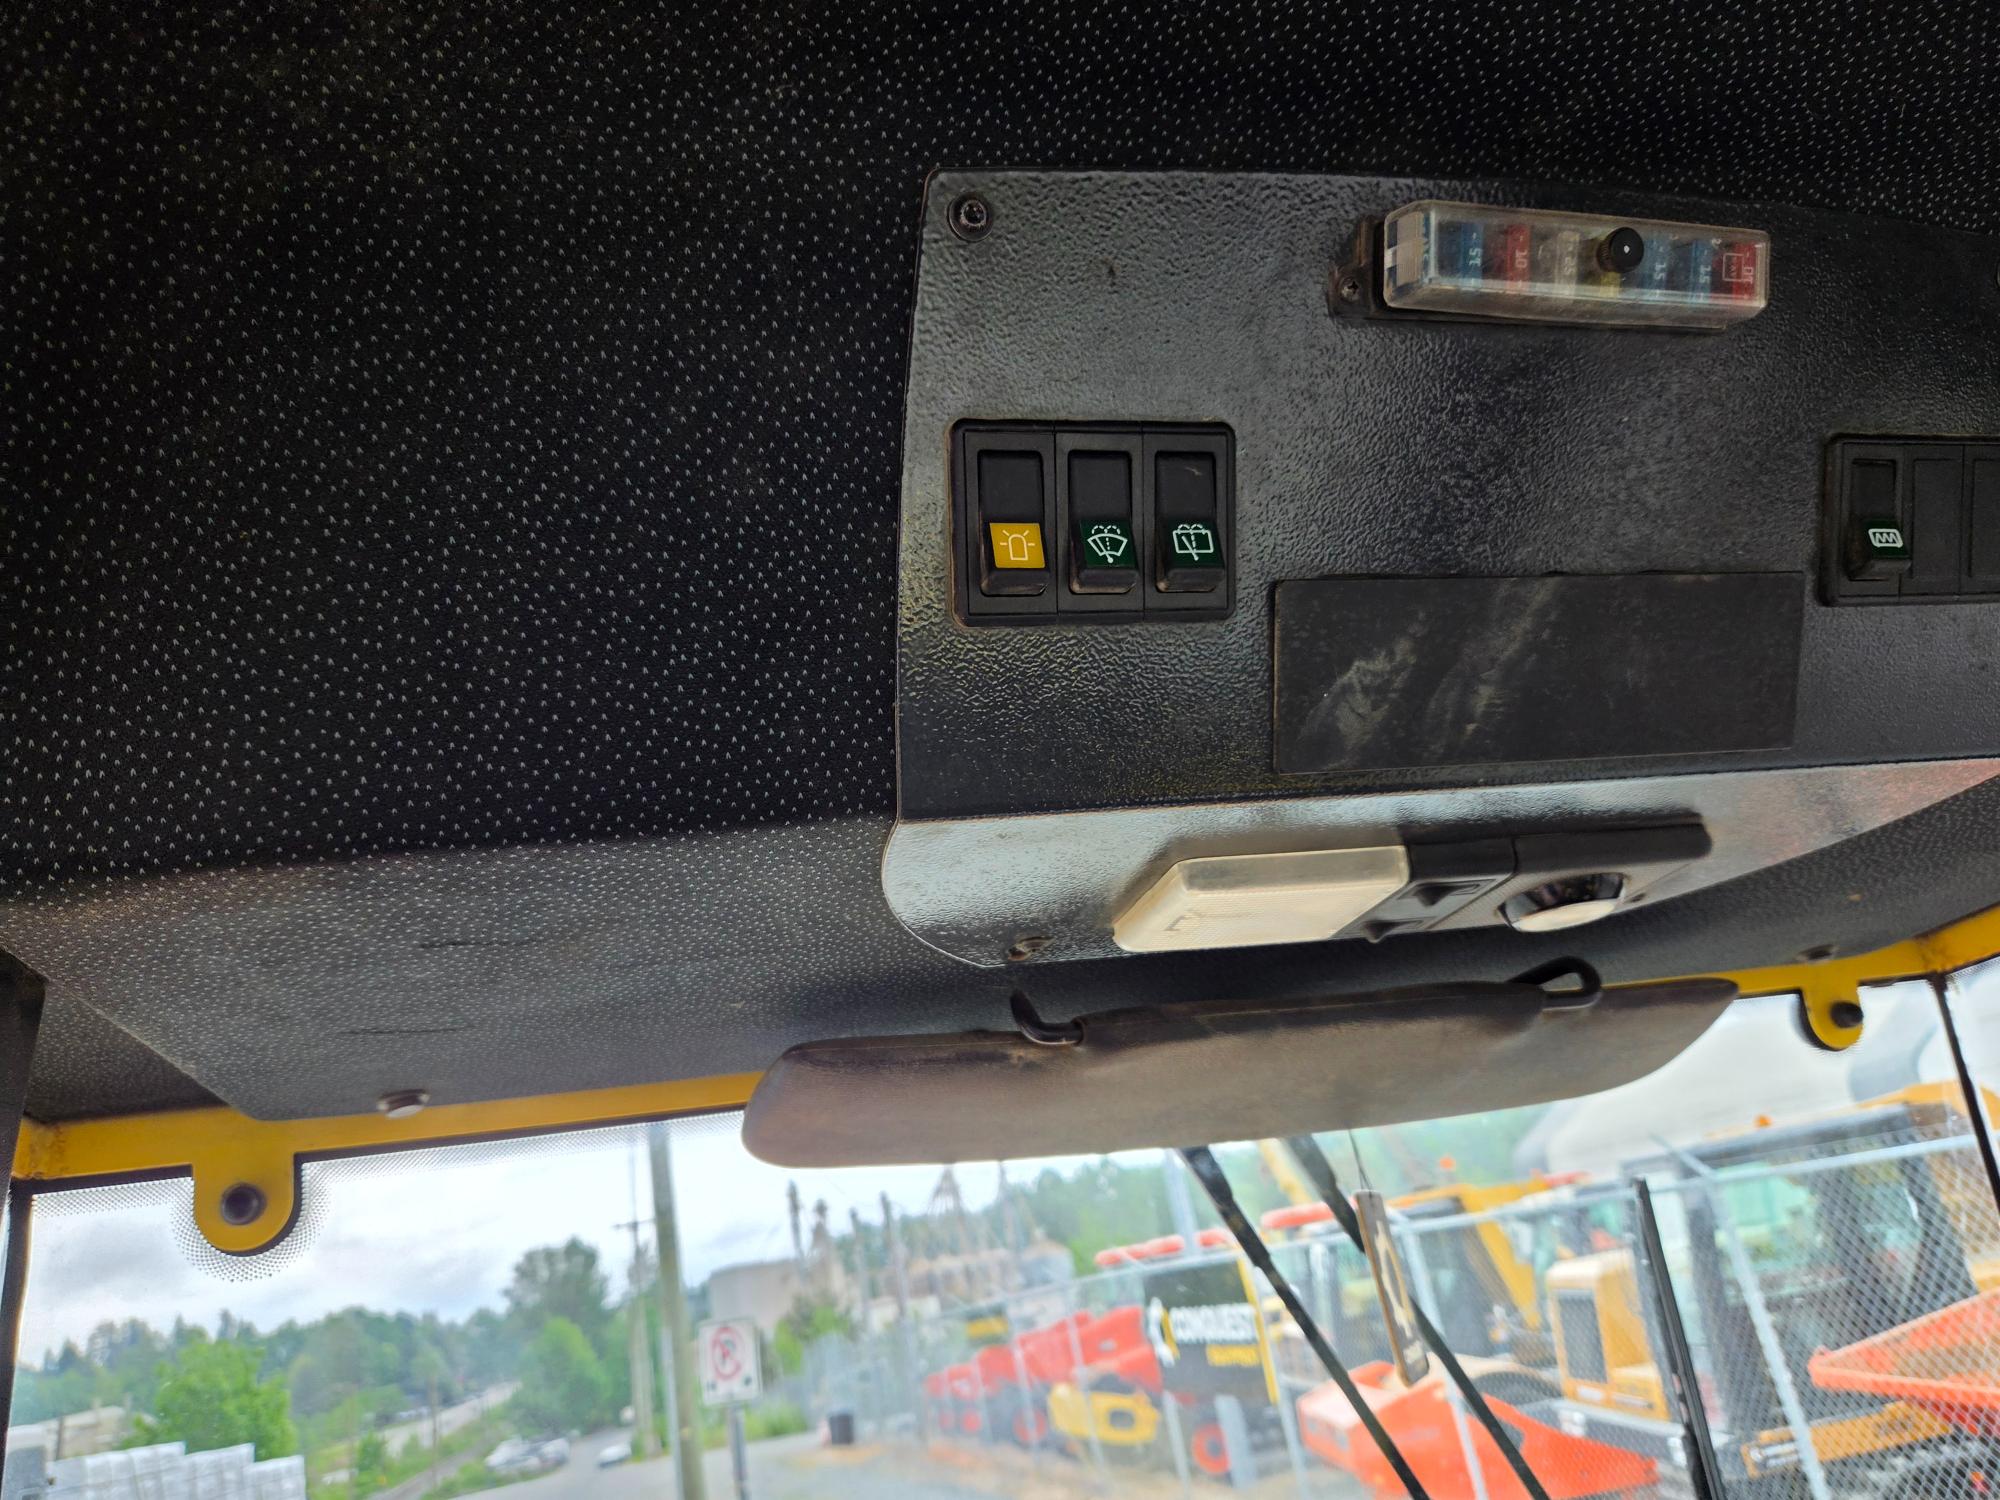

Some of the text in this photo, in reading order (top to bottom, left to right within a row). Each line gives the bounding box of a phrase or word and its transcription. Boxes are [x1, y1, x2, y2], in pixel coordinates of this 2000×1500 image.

[1468, 247, 1482, 267] 15
[1515, 248, 1528, 268] 10
[1655, 262, 1667, 281] 15
[1700, 264, 1712, 284] 15
